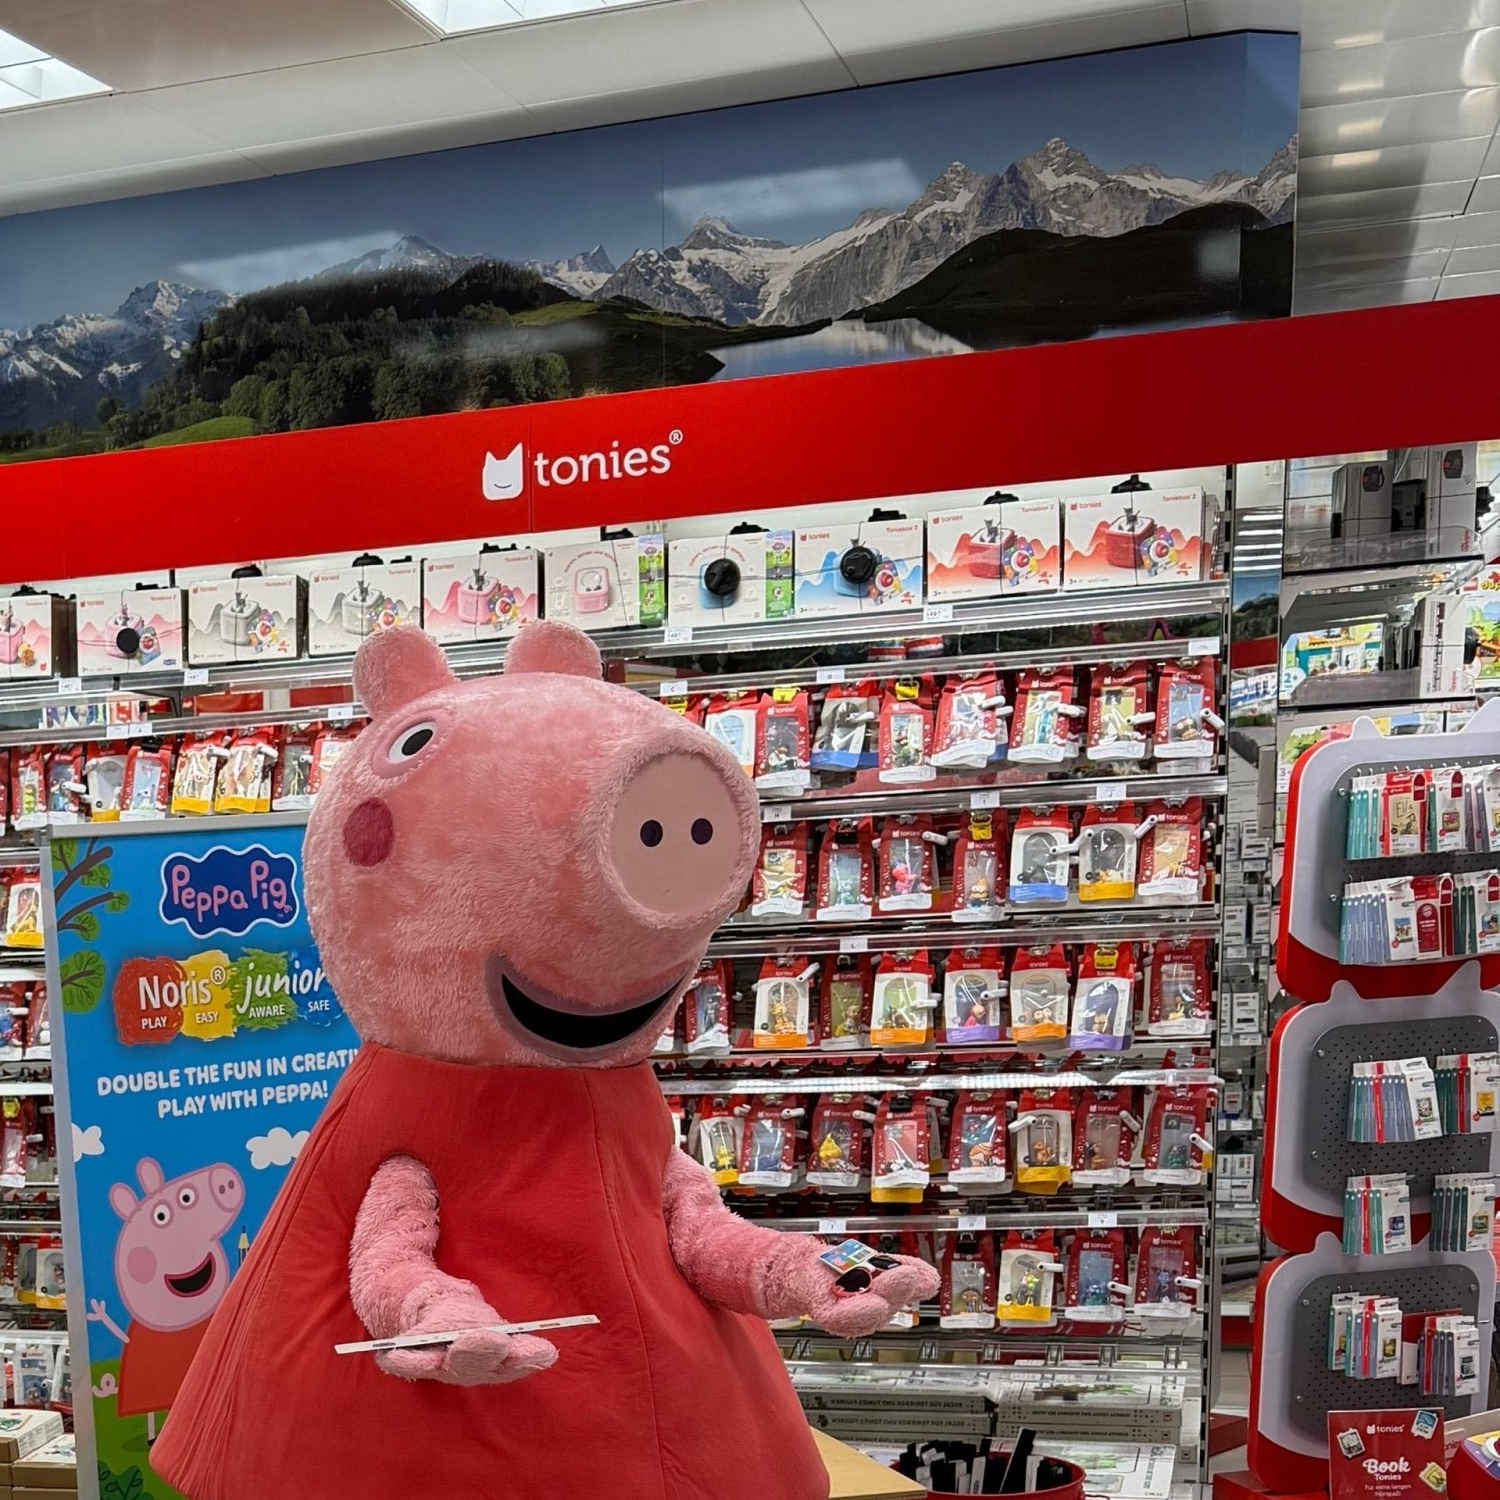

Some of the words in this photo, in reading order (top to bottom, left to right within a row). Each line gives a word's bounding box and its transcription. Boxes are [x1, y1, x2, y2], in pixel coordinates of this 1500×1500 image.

[172, 864, 248, 923] Peppa
[250, 860, 293, 914] Pig
[237, 960, 326, 1014] junior
[142, 1016, 168, 1030] PLAY
[196, 1011, 219, 1025] EASY
[249, 1004, 285, 1019] AWARE
[307, 999, 330, 1013] SAFE
[97, 1068, 181, 1096] DOUBLE
[184, 1063, 220, 1087] THE
[223, 1059, 262, 1081] FUN
[266, 1056, 288, 1075] IN
[292, 1048, 358, 1073] CREATI
[158, 1098, 208, 1119] PLAY
[210, 1090, 258, 1112] WITH
[262, 1080, 328, 1106] PEPPA!
[1376, 1425, 1405, 1433] tonies
[1363, 1457, 1411, 1474] Book
